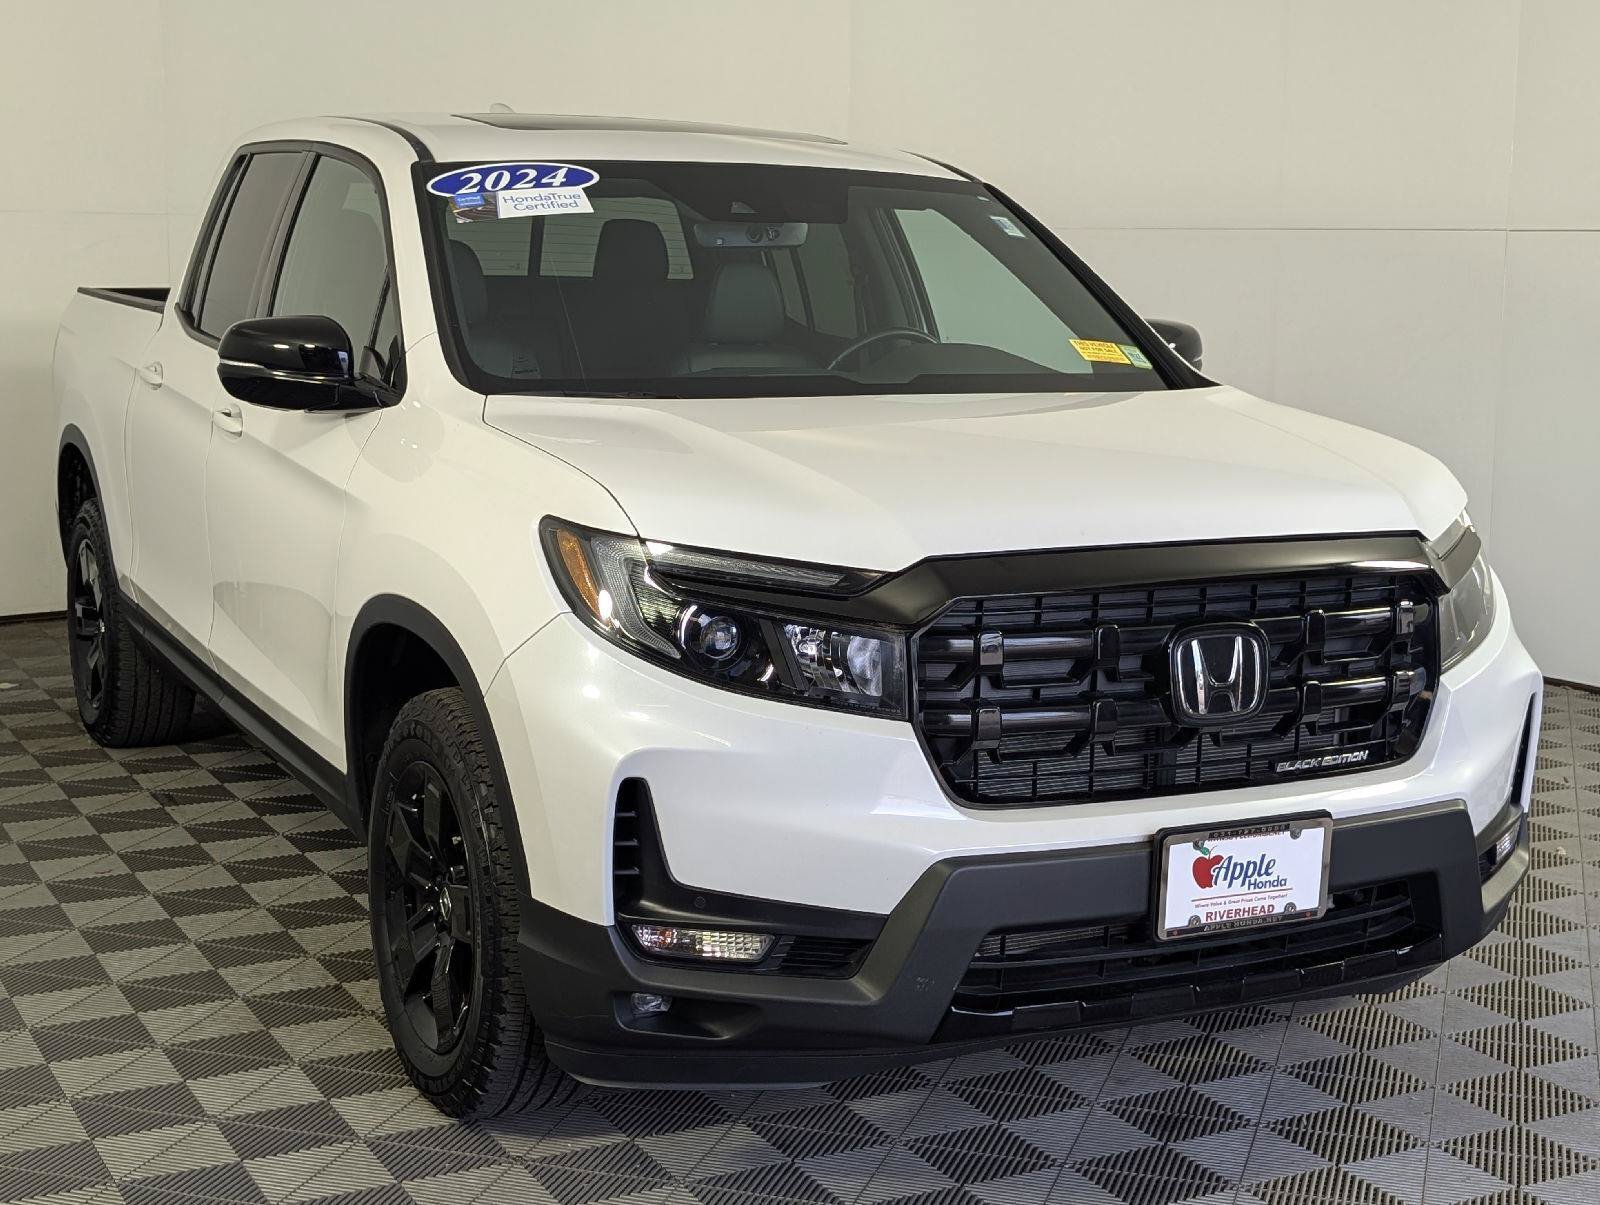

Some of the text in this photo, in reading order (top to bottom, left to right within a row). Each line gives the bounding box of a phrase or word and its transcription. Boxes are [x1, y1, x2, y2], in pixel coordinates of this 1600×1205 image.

[455, 167, 569, 195] 2024
[502, 192, 582, 205] HondaTrue
[512, 200, 580, 212] Certified
[1276, 749, 1369, 773] BLACK EDITION
[1212, 853, 1277, 889] Apple
[1247, 874, 1288, 891] Honda
[1205, 903, 1275, 922] RIVERHEAD
